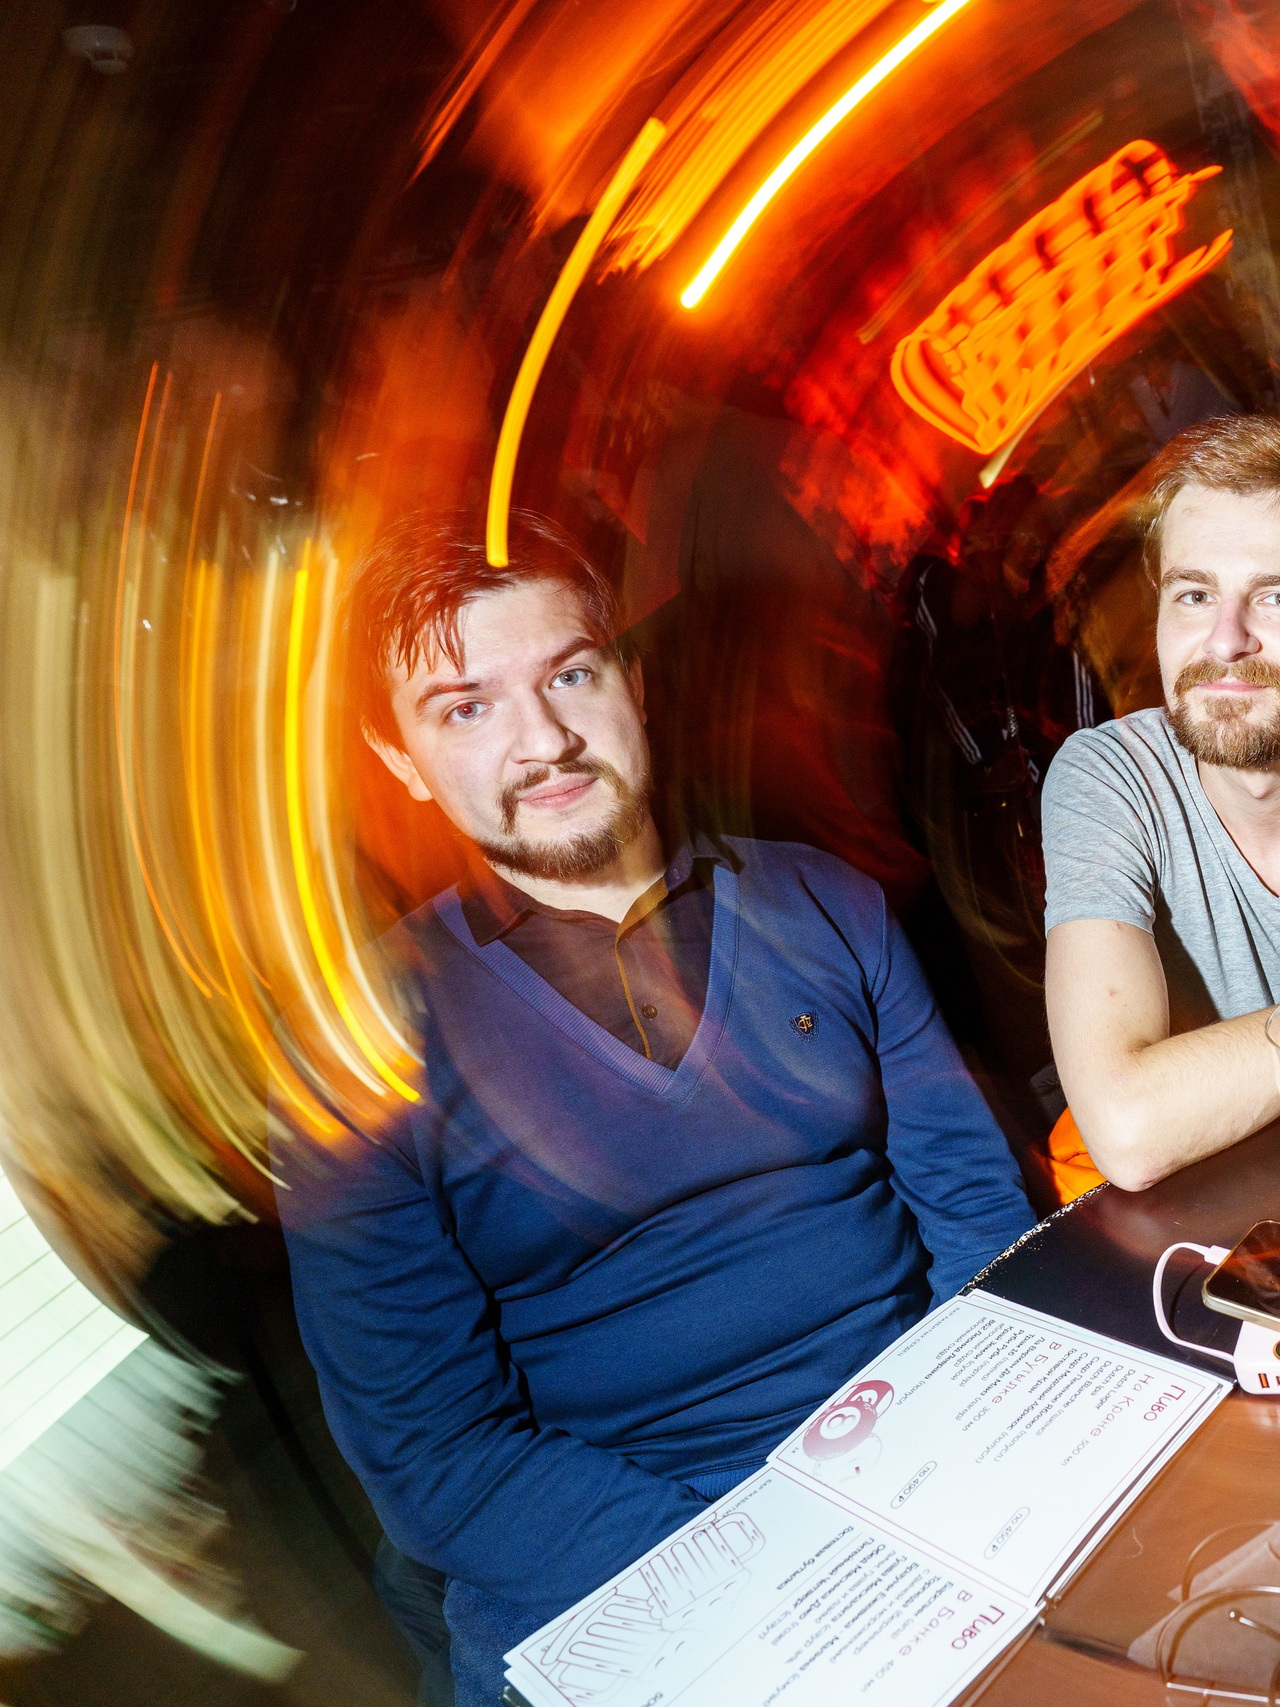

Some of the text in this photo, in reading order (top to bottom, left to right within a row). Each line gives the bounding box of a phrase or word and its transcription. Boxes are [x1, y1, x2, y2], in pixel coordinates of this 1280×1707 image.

[994, 1325, 1015, 1341] Край
[1005, 1329, 1025, 1345] Руби
[1015, 1333, 1036, 1349] Трам
[973, 1340, 998, 1360] Земли
[988, 1343, 1008, 1360] Руби
[1027, 1347, 1078, 1394] Гостевой Кран
[1068, 1352, 1089, 1370] Сидр
[1079, 1356, 1100, 1374] Сидр
[1089, 1360, 1113, 1381] Dutch
[991, 1353, 1049, 1404] Бутылке
[1037, 1369, 1071, 1401] Медовый
[1101, 1364, 1125, 1385] Dutch
[1132, 1373, 1155, 1392] На
[1062, 1380, 1093, 1409] Blanche
[1095, 1368, 1137, 1410] Dutch Lager
[1143, 1384, 1187, 1421] Пиво
[826, 1412, 857, 1430] 8
[972, 1405, 991, 1422] 300
[1006, 1400, 1039, 1431] Абрикос
[1025, 1403, 1054, 1430] Яблоко
[1090, 1395, 1135, 1437] Кране
[1071, 1439, 1090, 1456] 500
[898, 1606, 956, 1656] Банке
[951, 1604, 1006, 1650] Пиво
